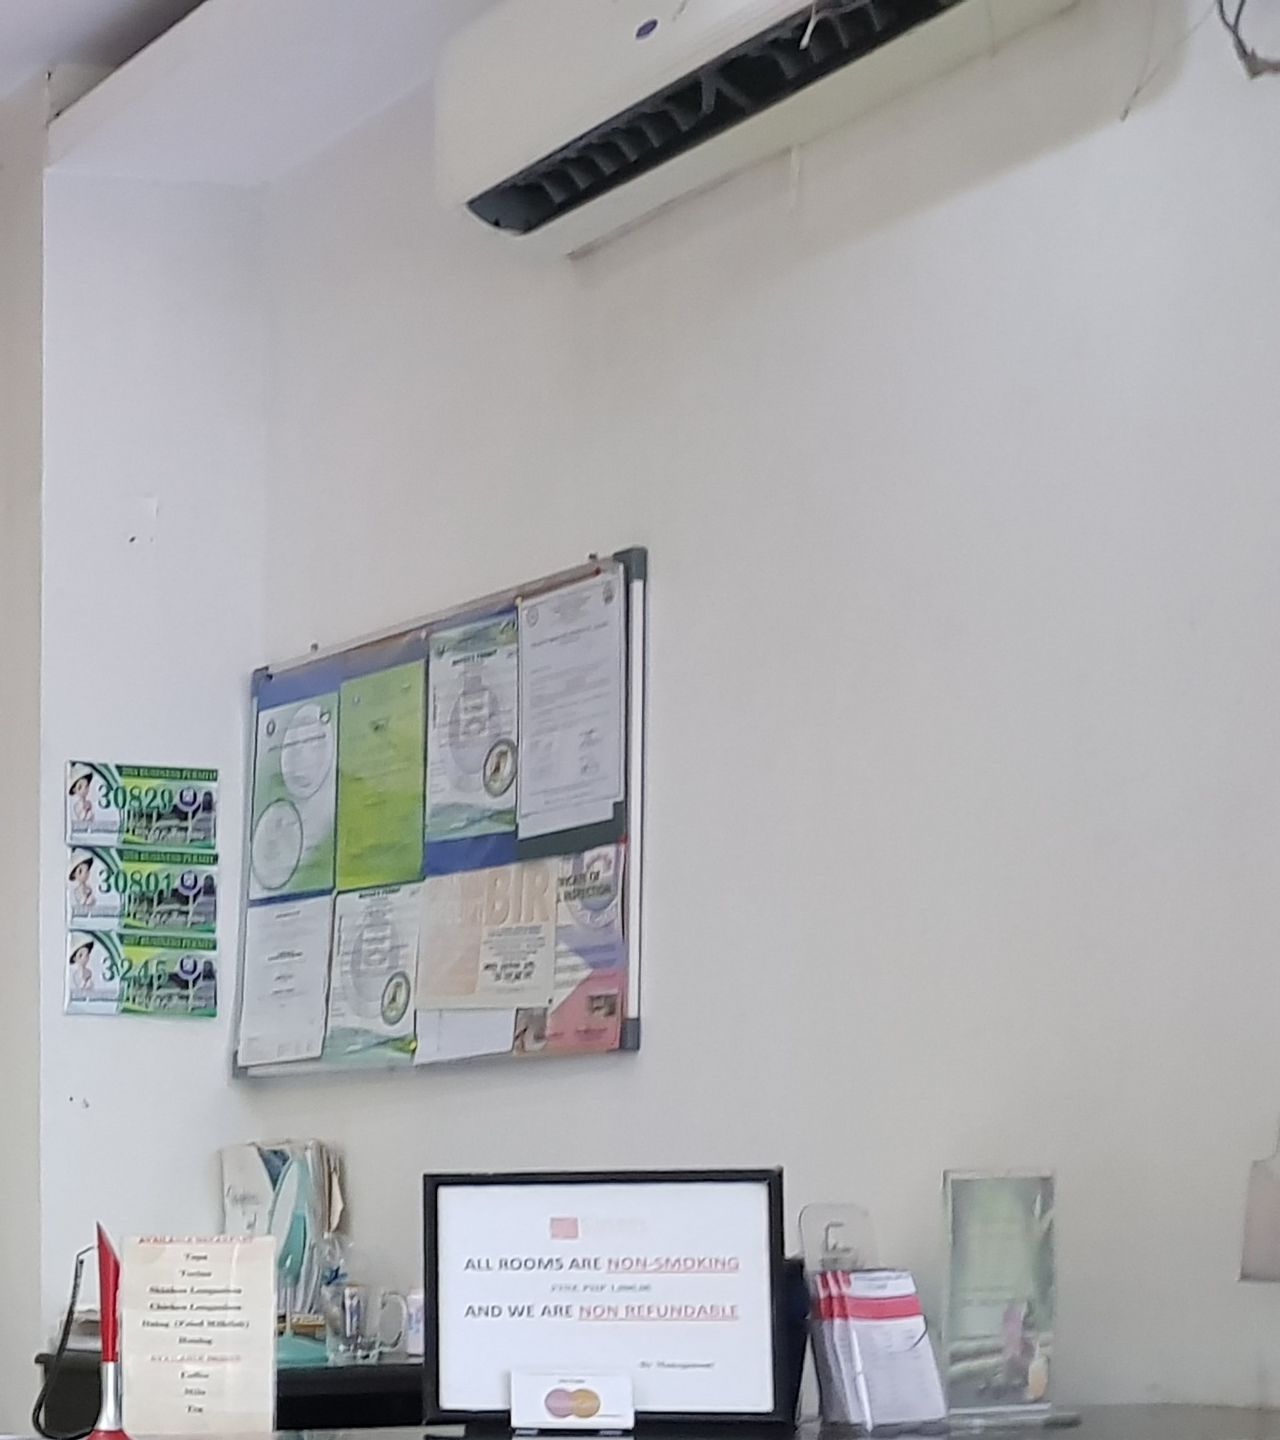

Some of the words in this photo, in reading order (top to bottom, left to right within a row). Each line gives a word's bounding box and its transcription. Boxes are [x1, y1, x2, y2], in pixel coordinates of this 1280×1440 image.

[98, 870, 172, 895] 30801
[464, 1257, 494, 1272] ALL
[498, 1257, 564, 1271] ROOMS
[568, 1257, 602, 1271] ARE
[607, 1256, 740, 1273] NON-SMOKING
[464, 1304, 503, 1319] AND
[507, 1304, 535, 1318] WE
[541, 1304, 573, 1318] ARE
[578, 1304, 618, 1318] NON
[625, 1304, 740, 1319] REFUNDABLE
